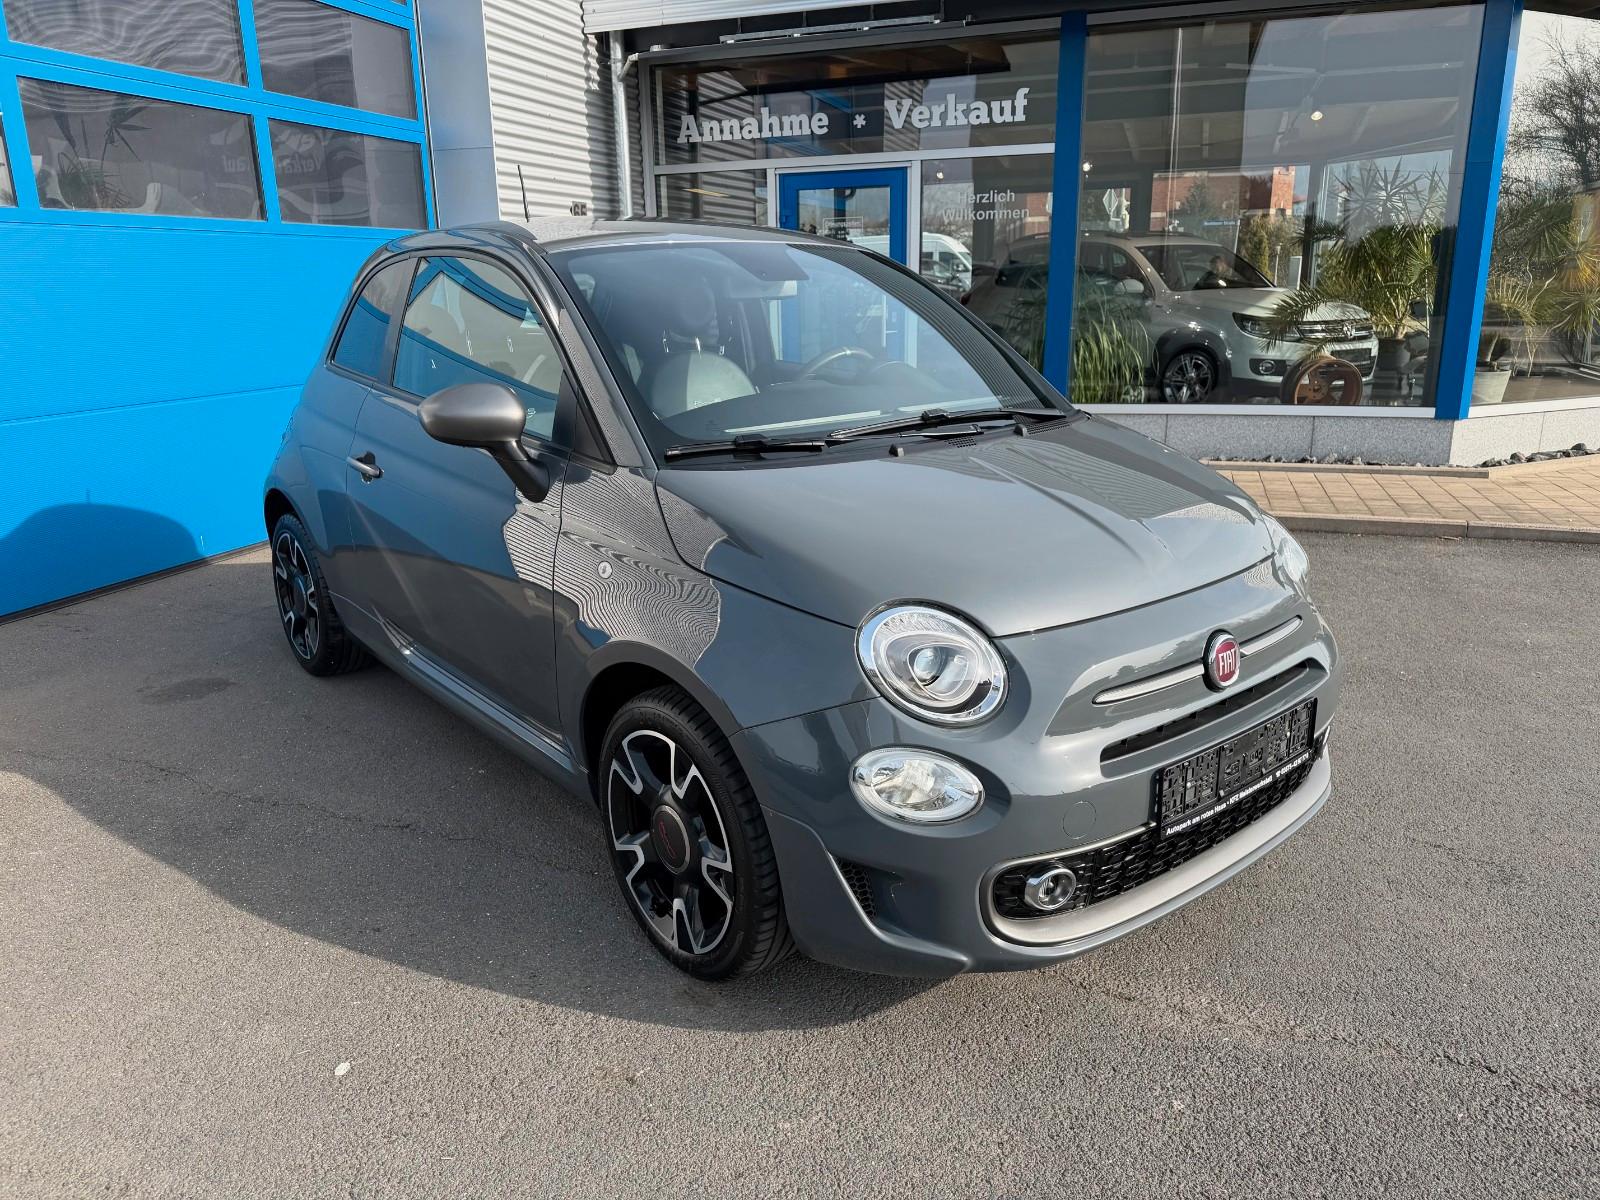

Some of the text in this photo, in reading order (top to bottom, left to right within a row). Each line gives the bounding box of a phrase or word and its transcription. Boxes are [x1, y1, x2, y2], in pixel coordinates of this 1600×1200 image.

[677, 87, 1030, 144] Annahme Verkauf
[959, 189, 1016, 204] Herzlich
[942, 208, 1030, 221] Willkommen
[1218, 648, 1237, 677] FIAT
[1166, 819, 1192, 836] Autopark
